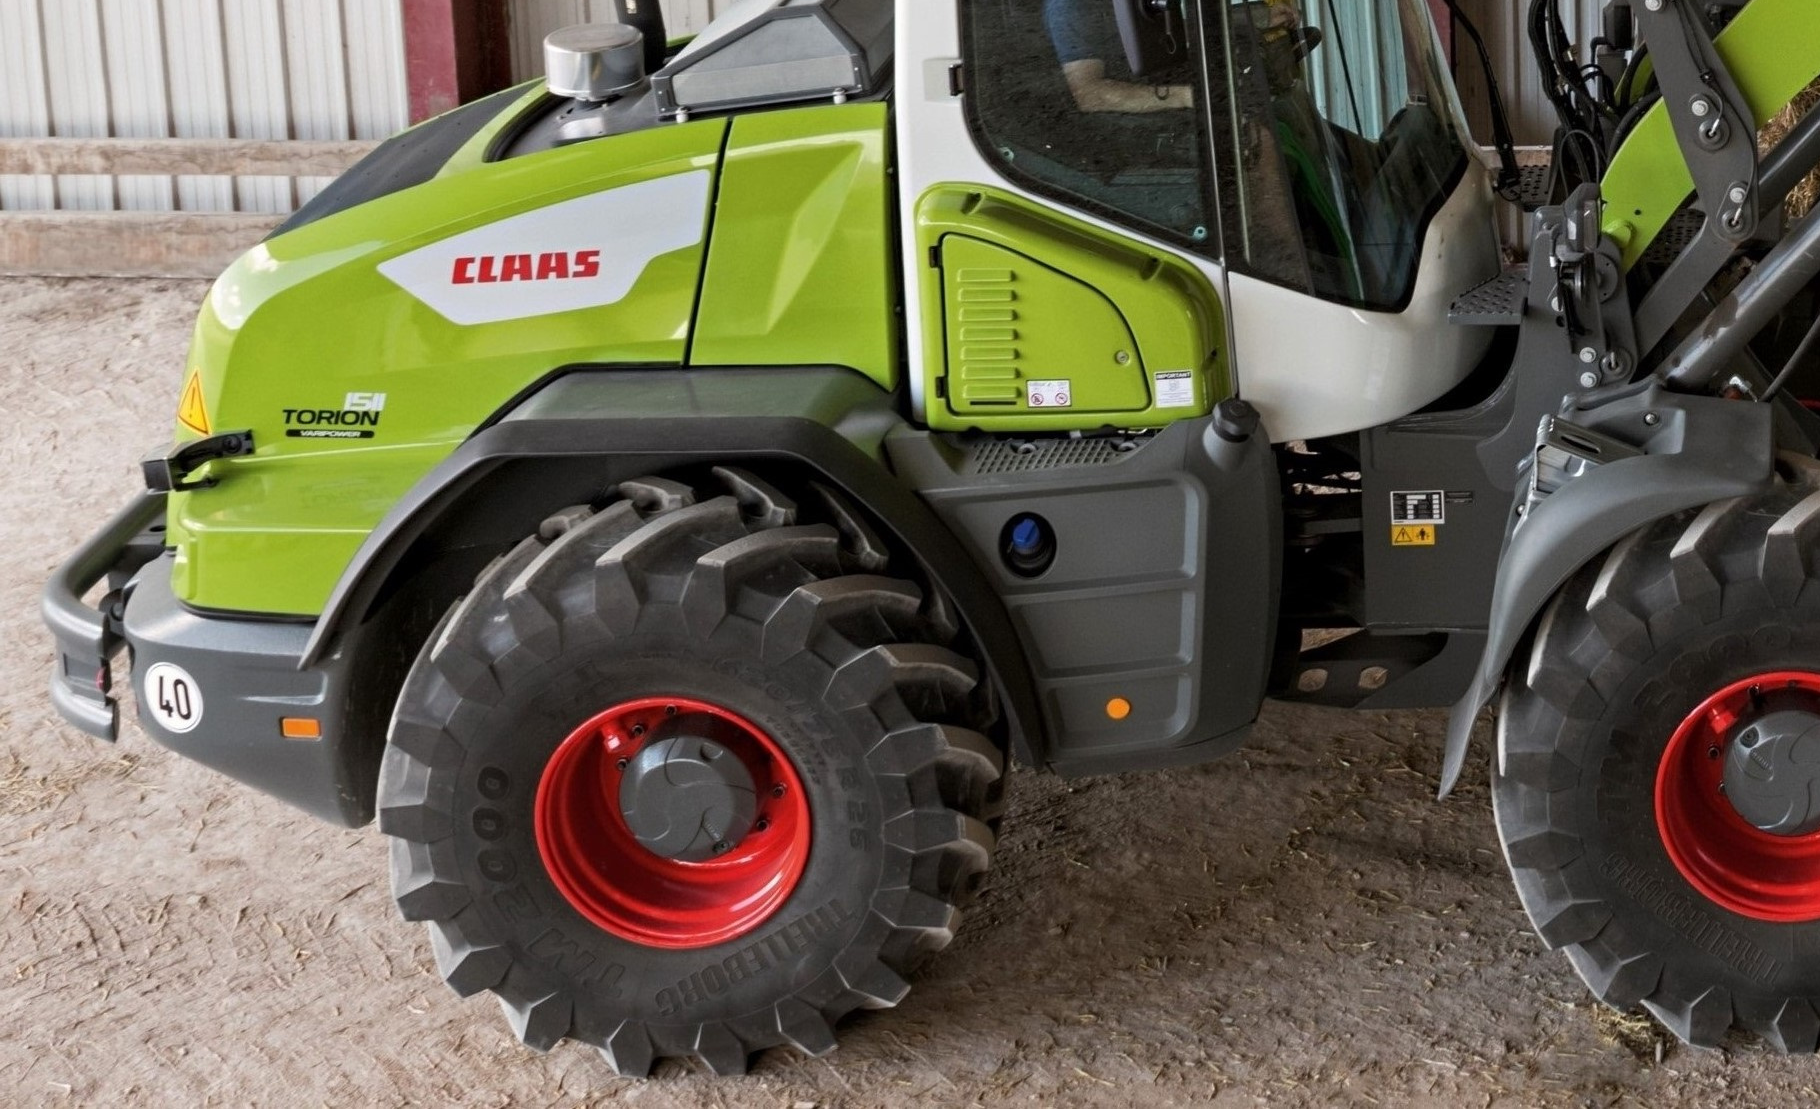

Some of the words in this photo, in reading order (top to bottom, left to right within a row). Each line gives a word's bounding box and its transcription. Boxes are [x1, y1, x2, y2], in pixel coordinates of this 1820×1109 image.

[451, 249, 600, 285] CLAAS
[282, 409, 380, 426] TORION
[159, 675, 192, 721] 40
[1600, 851, 1783, 984] TRELLEBORG
[654, 897, 854, 1018] TRELLEBORG
